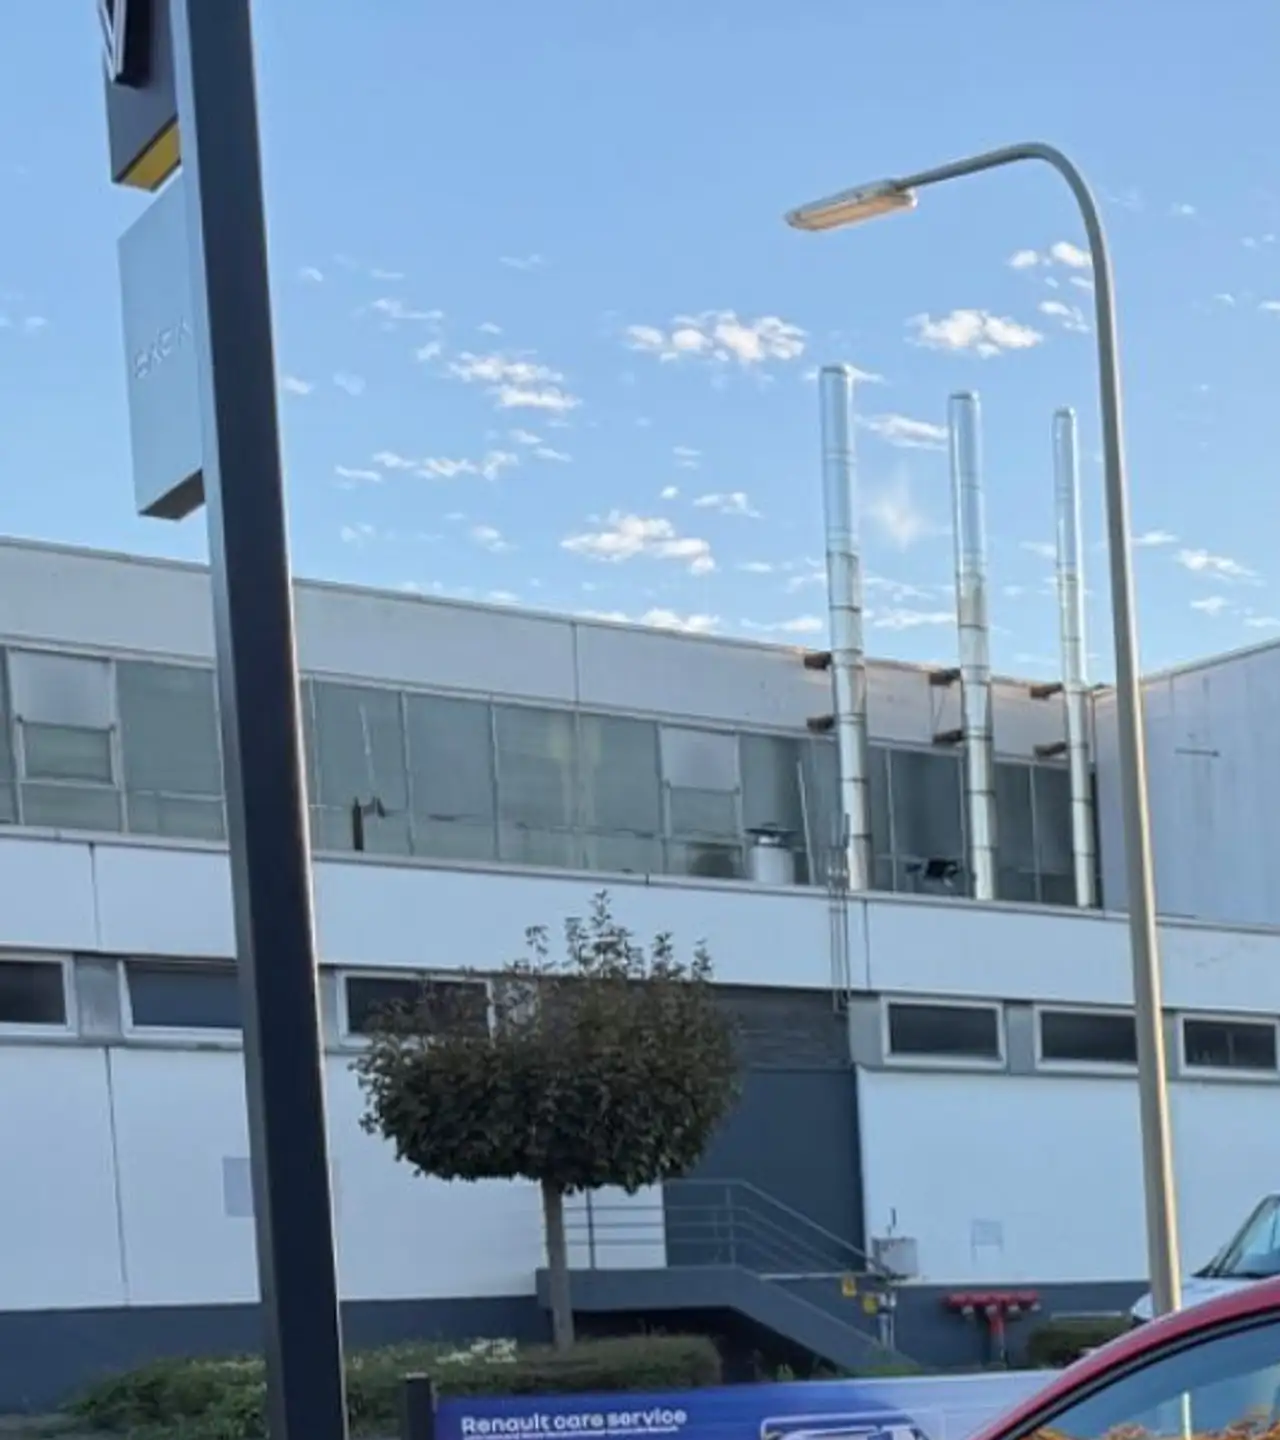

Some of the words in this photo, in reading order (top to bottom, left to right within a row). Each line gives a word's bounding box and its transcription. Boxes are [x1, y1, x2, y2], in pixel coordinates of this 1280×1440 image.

[461, 1412, 551, 1434] Renault
[553, 1414, 604, 1431] care
[606, 1407, 688, 1427] service
